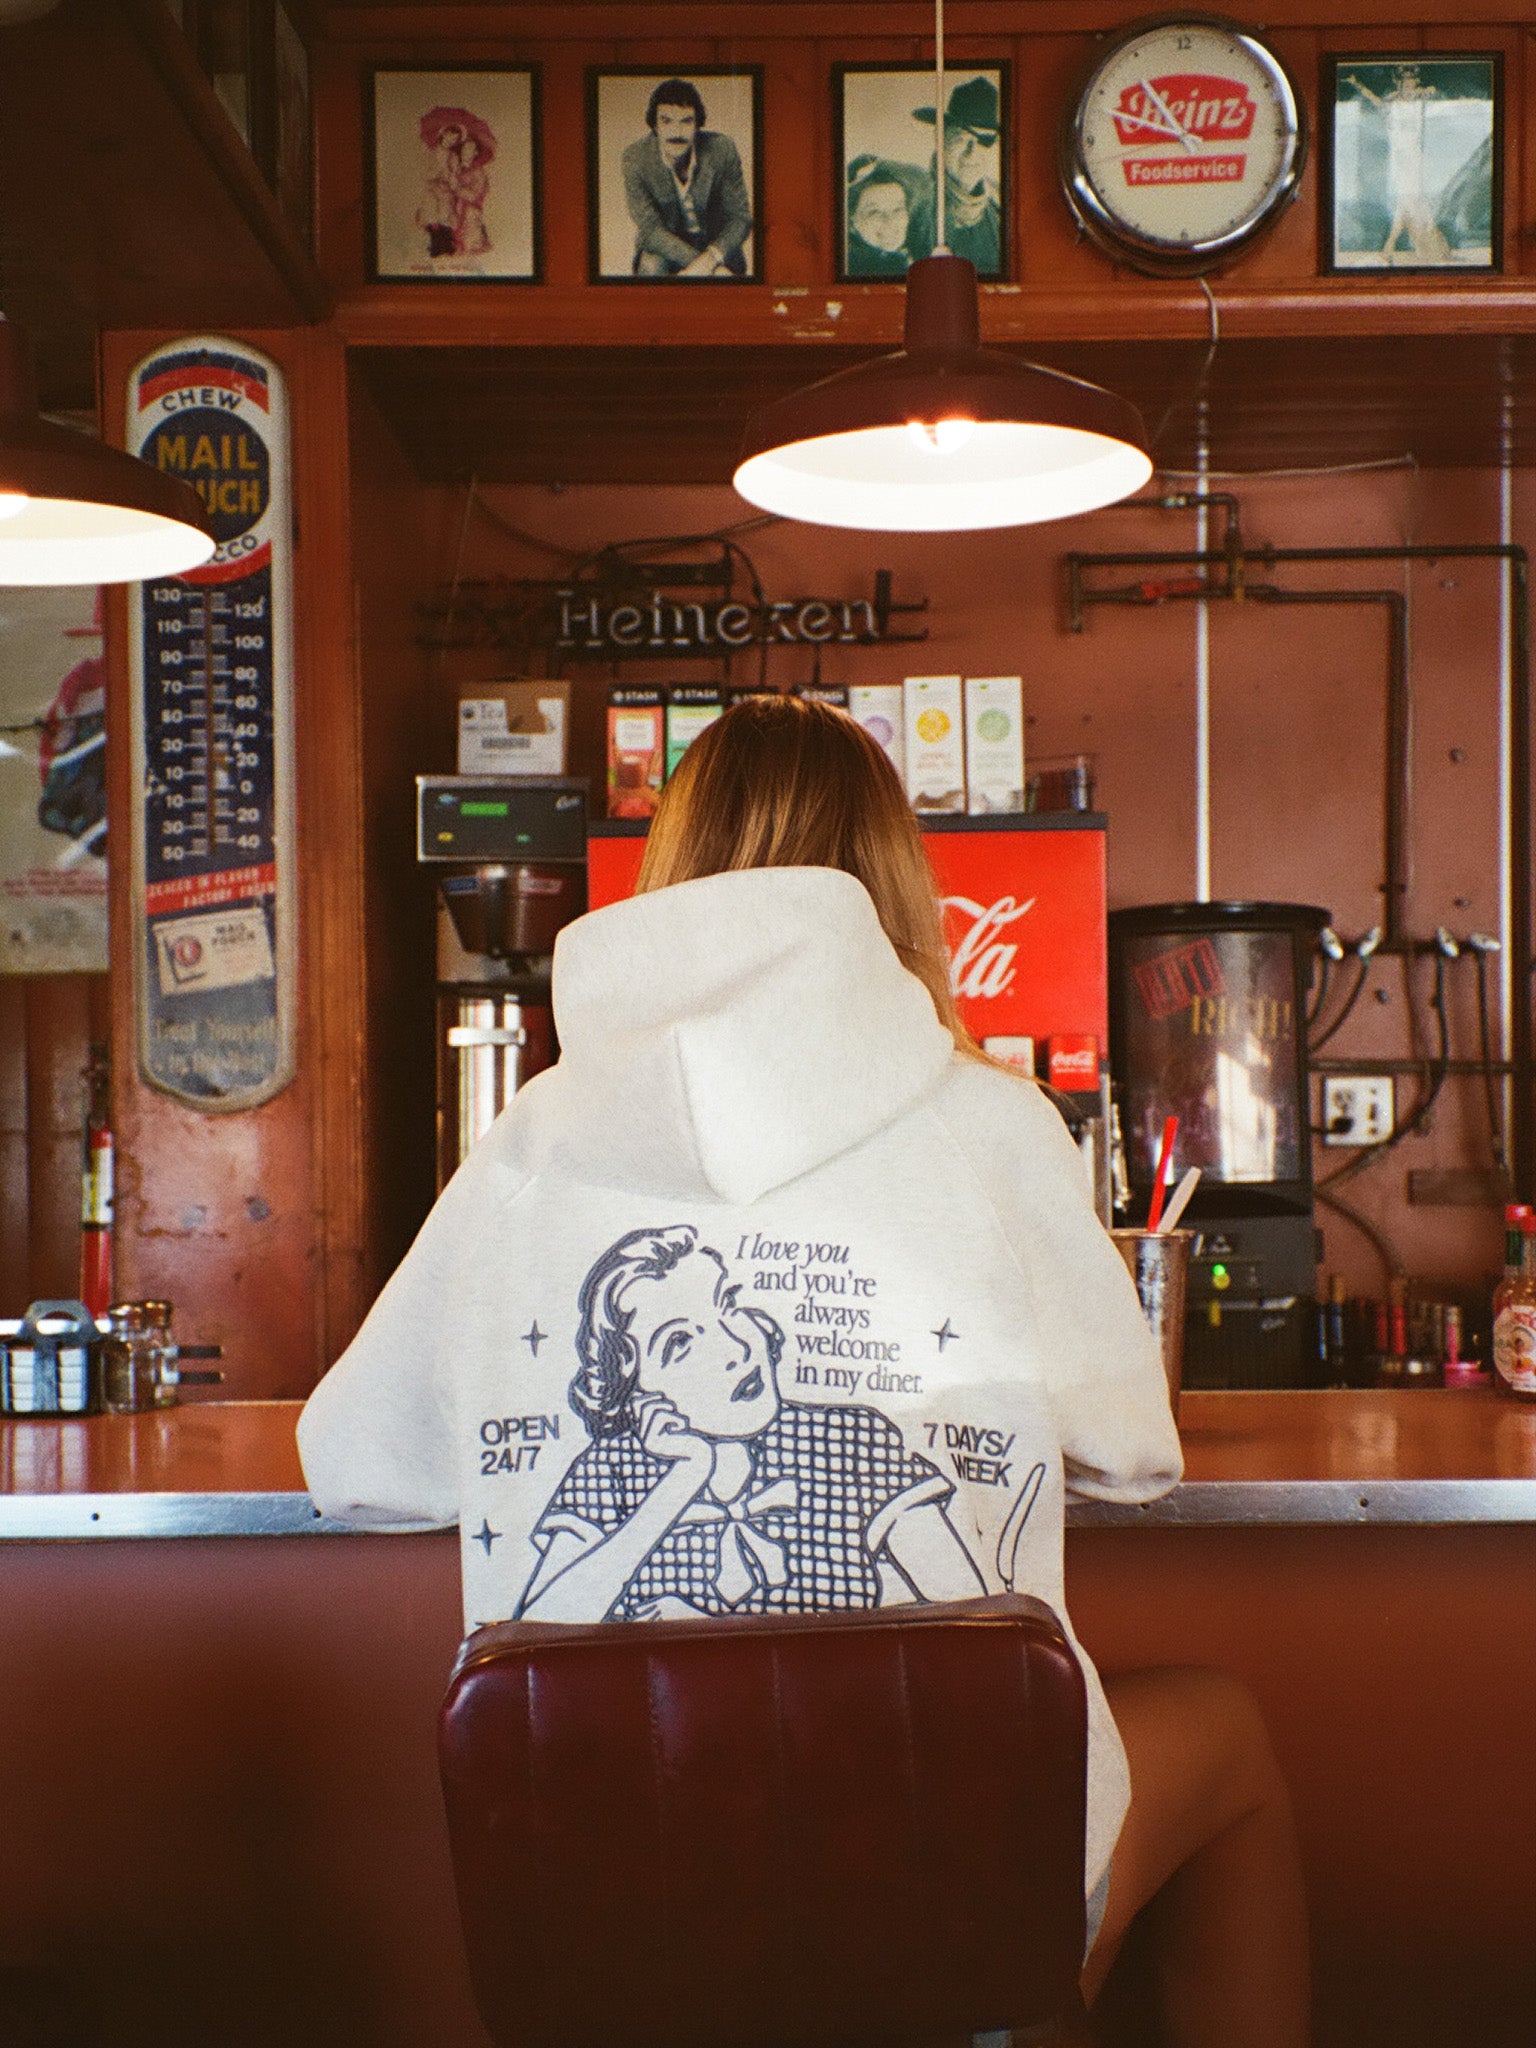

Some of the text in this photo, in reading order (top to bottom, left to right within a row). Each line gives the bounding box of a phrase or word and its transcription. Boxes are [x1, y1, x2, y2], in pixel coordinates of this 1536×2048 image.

[1176, 36, 1192, 50] 12
[1119, 88, 1248, 134] Heinz
[1130, 160, 1238, 181] Foodservice
[161, 387, 241, 412] CHEW
[157, 434, 258, 471] MAIL
[190, 479, 260, 514] UCH
[153, 587, 182, 602] 130
[556, 588, 876, 645] Heineken
[157, 618, 182, 634] 110
[235, 634, 265, 650] 100
[160, 649, 183, 665] 90
[234, 666, 259, 682] 80
[161, 679, 183, 695] 70
[684, 689, 719, 700] STASH
[234, 694, 259, 710] 60
[625, 691, 659, 702] STASH
[160, 708, 184, 724] 50
[235, 722, 260, 739] 40
[161, 737, 184, 753] 30
[236, 751, 260, 768] 20
[166, 765, 184, 781] 10
[240, 779, 254, 795] 0
[166, 793, 184, 809] 10
[236, 807, 260, 823] 20
[161, 819, 185, 835] 30
[236, 833, 261, 849] 40
[161, 845, 185, 861] 50
[735, 1232, 850, 1269] I love you
[753, 1264, 877, 1299] and you're
[794, 1296, 871, 1335] always
[795, 1329, 901, 1362] welcome
[795, 1358, 924, 1396] in my diner.
[480, 1414, 560, 1446] OPEN
[922, 1422, 1017, 1458] 7 DAYS/
[481, 1445, 542, 1476] 24/7
[950, 1453, 1014, 1488] WEEK
